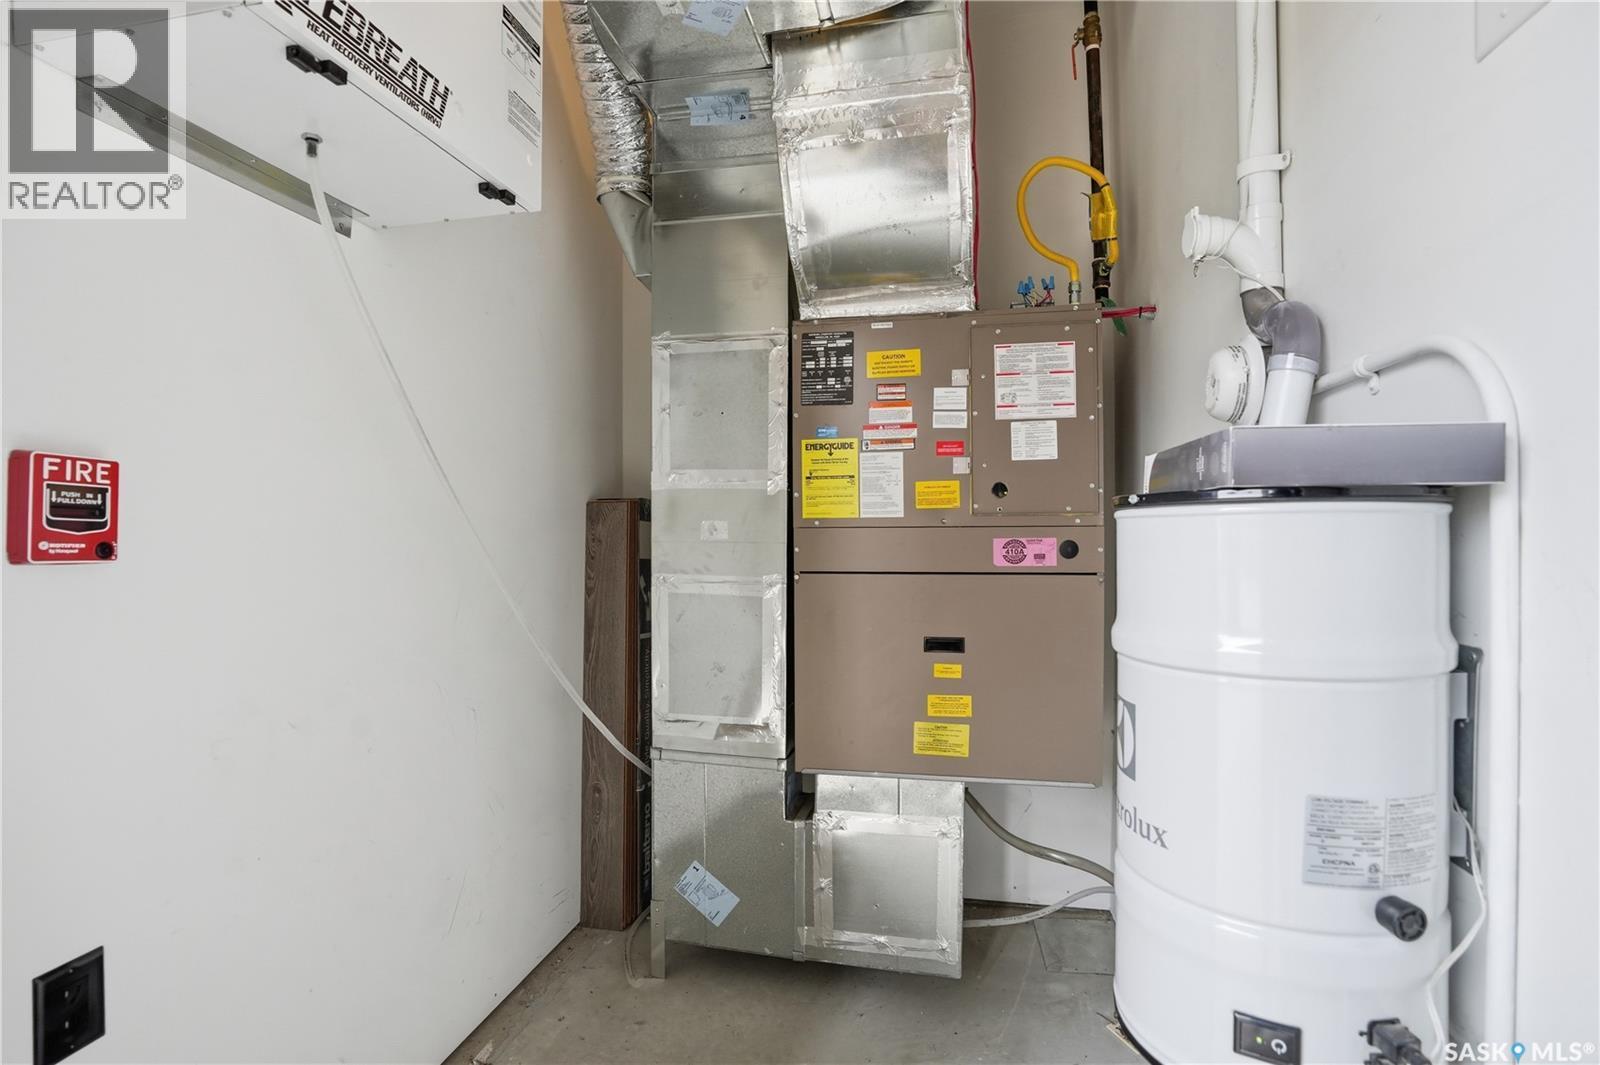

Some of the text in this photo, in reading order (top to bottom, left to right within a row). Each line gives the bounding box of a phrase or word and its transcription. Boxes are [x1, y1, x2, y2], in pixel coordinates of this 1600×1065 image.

[306, 19, 442, 129] HEAT RECOVERY VENTILATORS (HRVs)
[805, 441, 855, 454] ENERGYGUIDE
[42, 457, 111, 484] FIRE
[60, 490, 81, 498] PUSH
[642, 802, 651, 875] balterio
